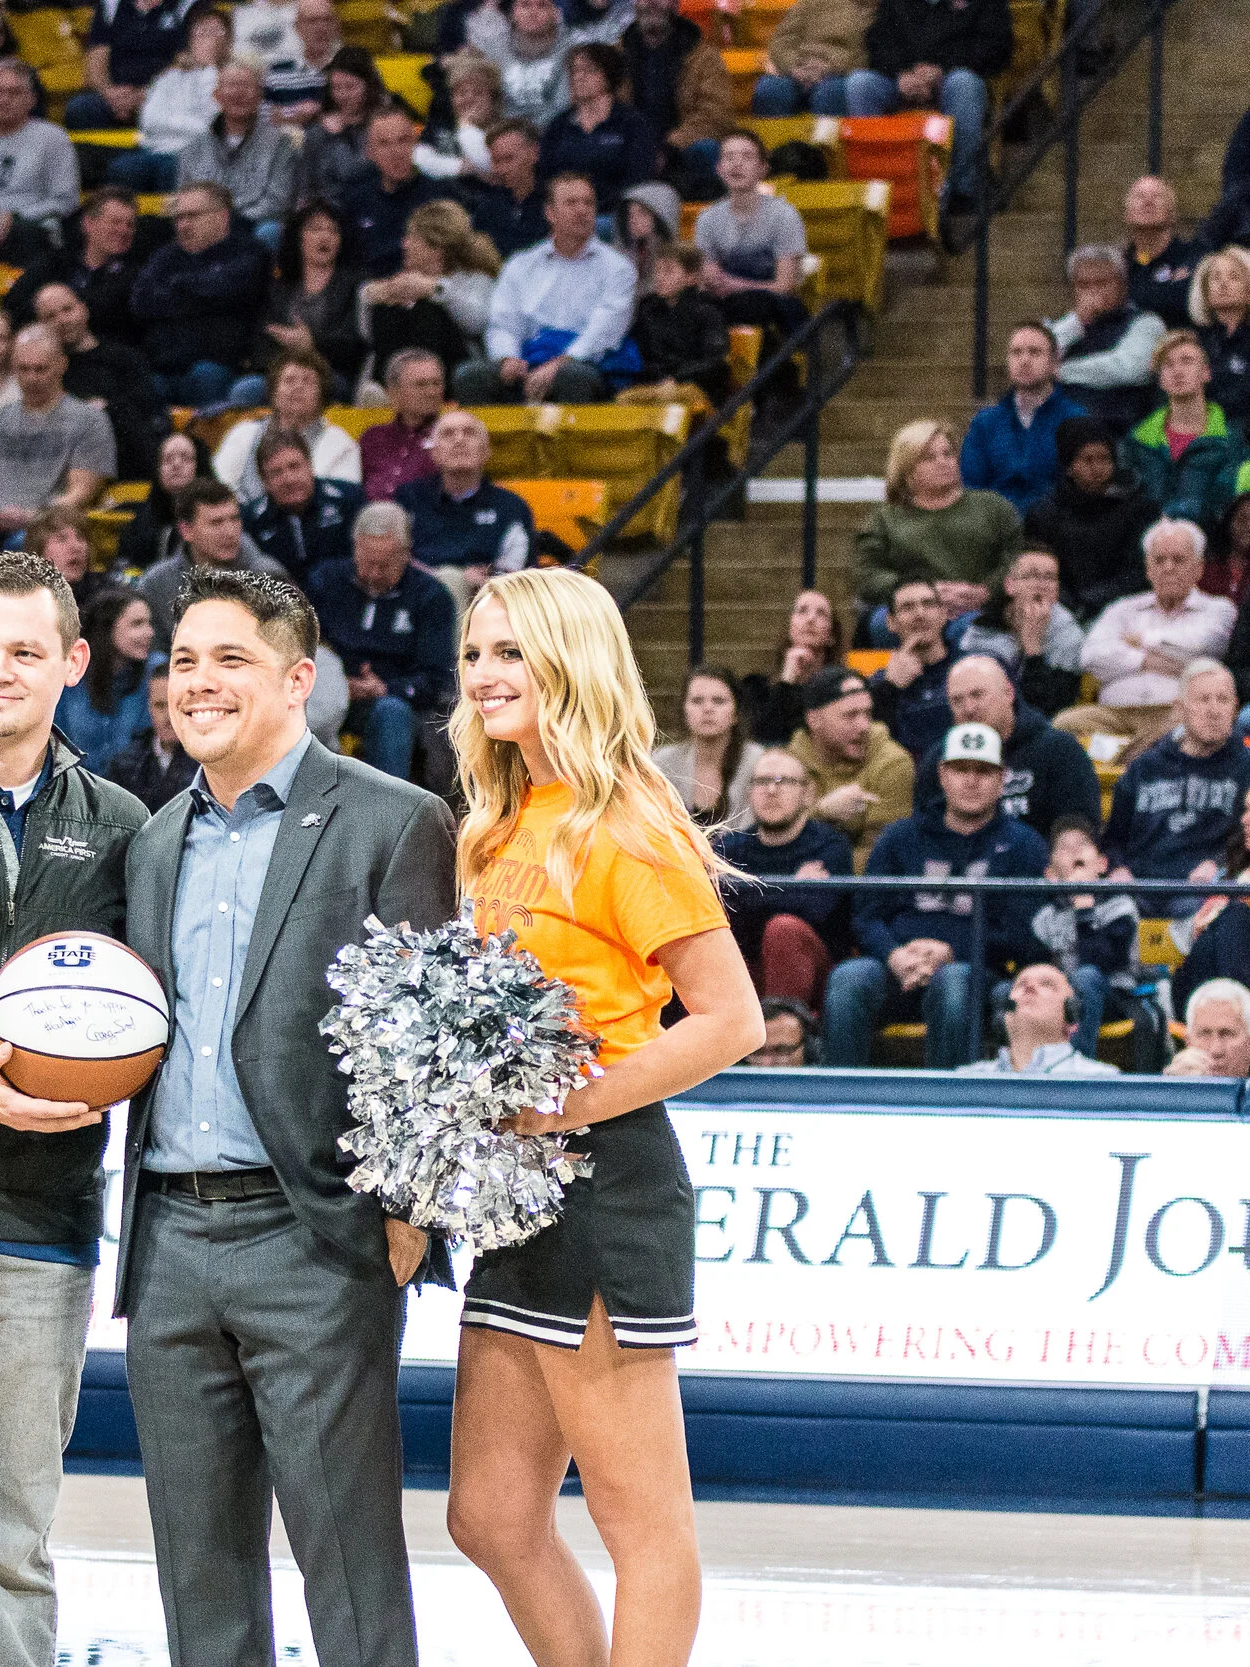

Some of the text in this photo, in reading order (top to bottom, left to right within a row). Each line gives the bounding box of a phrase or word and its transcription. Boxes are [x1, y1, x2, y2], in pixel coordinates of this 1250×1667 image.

[38, 843, 97, 858] AMERICA FIRST
[47, 949, 97, 961] STATE
[701, 1130, 794, 1167] THE
[693, 1184, 1059, 1272] ERALD
[1040, 1327, 1125, 1366] THE
